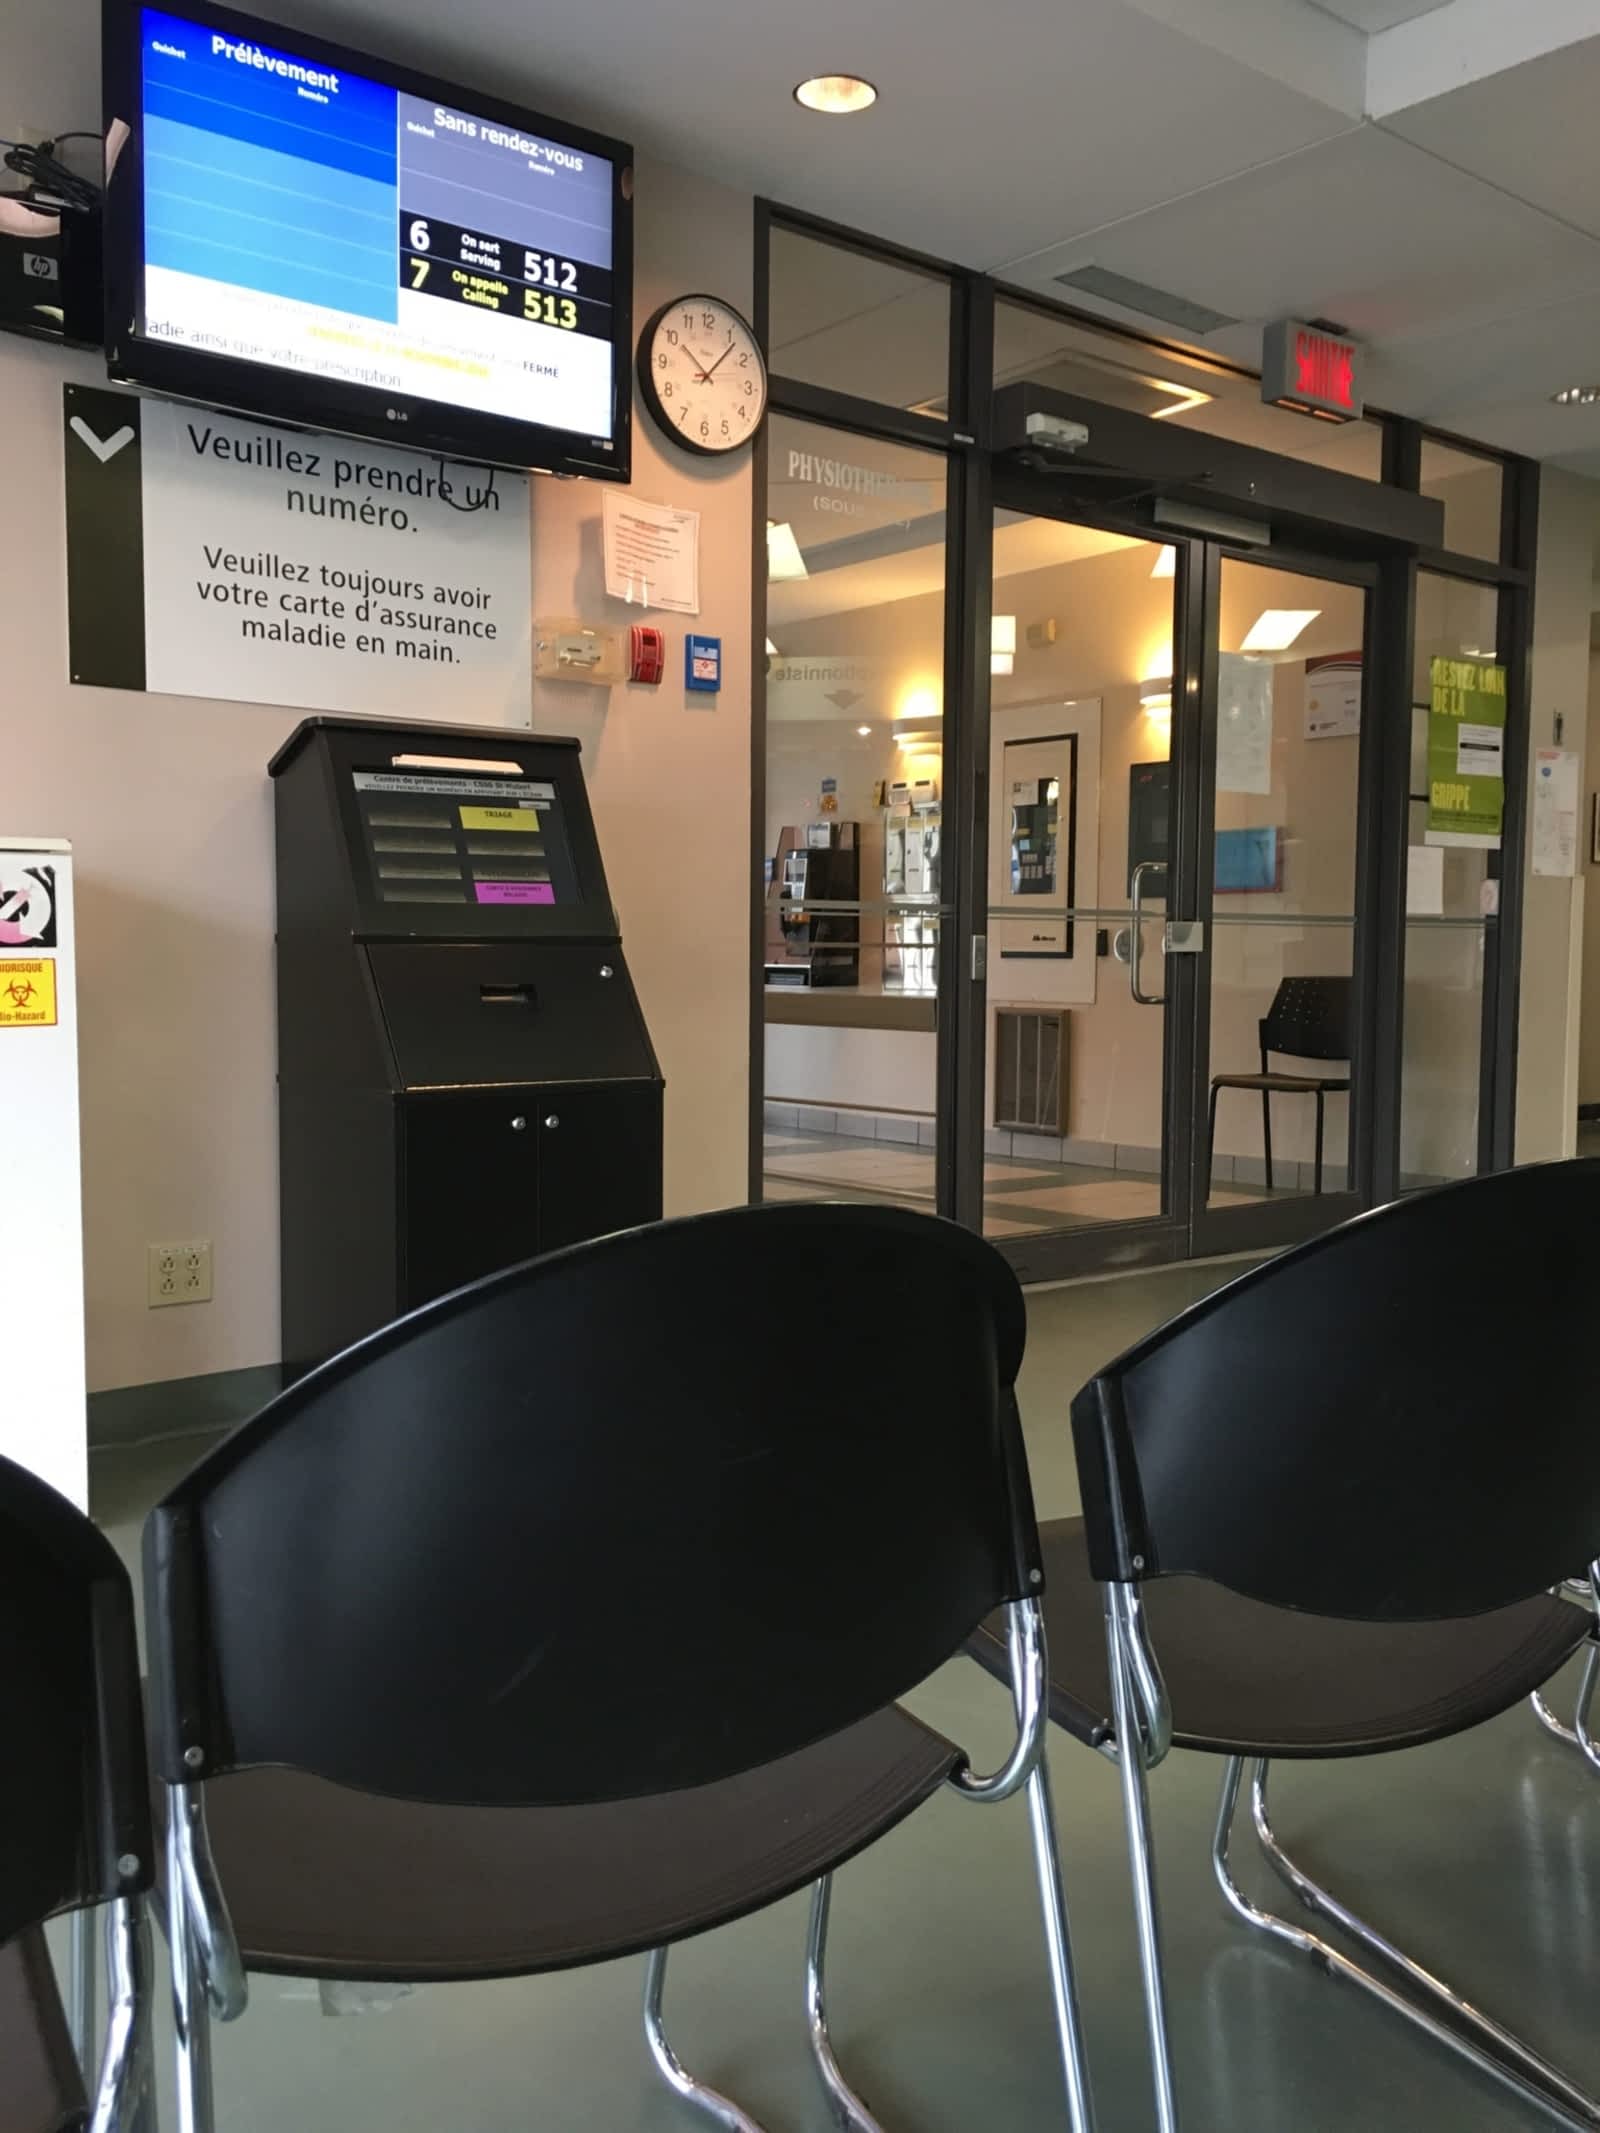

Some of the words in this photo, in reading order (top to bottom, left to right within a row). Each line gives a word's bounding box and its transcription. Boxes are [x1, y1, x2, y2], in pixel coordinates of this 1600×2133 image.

[211, 35, 339, 93] Prélèvement
[433, 108, 477, 137] Sans
[481, 126, 584, 172] rendez-vous
[410, 220, 430, 251] 6
[461, 233, 477, 248] On
[460, 249, 501, 271] Serving
[410, 257, 430, 288] 7
[524, 250, 578, 292] 512
[452, 270, 468, 284] On
[469, 276, 509, 296] appelle
[462, 287, 499, 309] Calling
[524, 288, 577, 329] 513
[683, 313, 694, 329] 11
[702, 313, 716, 330] 12
[666, 330, 679, 346] 10
[726, 330, 732, 344] 1
[658, 353, 668, 369] 9
[739, 352, 748, 368] 2
[664, 382, 673, 397] 8
[744, 380, 753, 396] 3
[680, 406, 689, 421] 7
[737, 405, 746, 420] 4
[700, 421, 709, 436] 6
[720, 420, 729, 435] 5
[187, 423, 321, 477] Veuillez
[334, 459, 453, 499] prendre
[465, 485, 500, 512] un
[286, 489, 418, 533] numéro.
[203, 545, 310, 583] Veuillez
[319, 565, 424, 598] toujours
[433, 586, 492, 610] avoir
[197, 581, 269, 608] votre
[279, 592, 345, 619] carte
[355, 599, 497, 640] d'assurance
[242, 618, 346, 649] maladie
[356, 634, 385, 655] en
[395, 639, 461, 664] main.
[0, 962, 43, 973] IORISQUE
